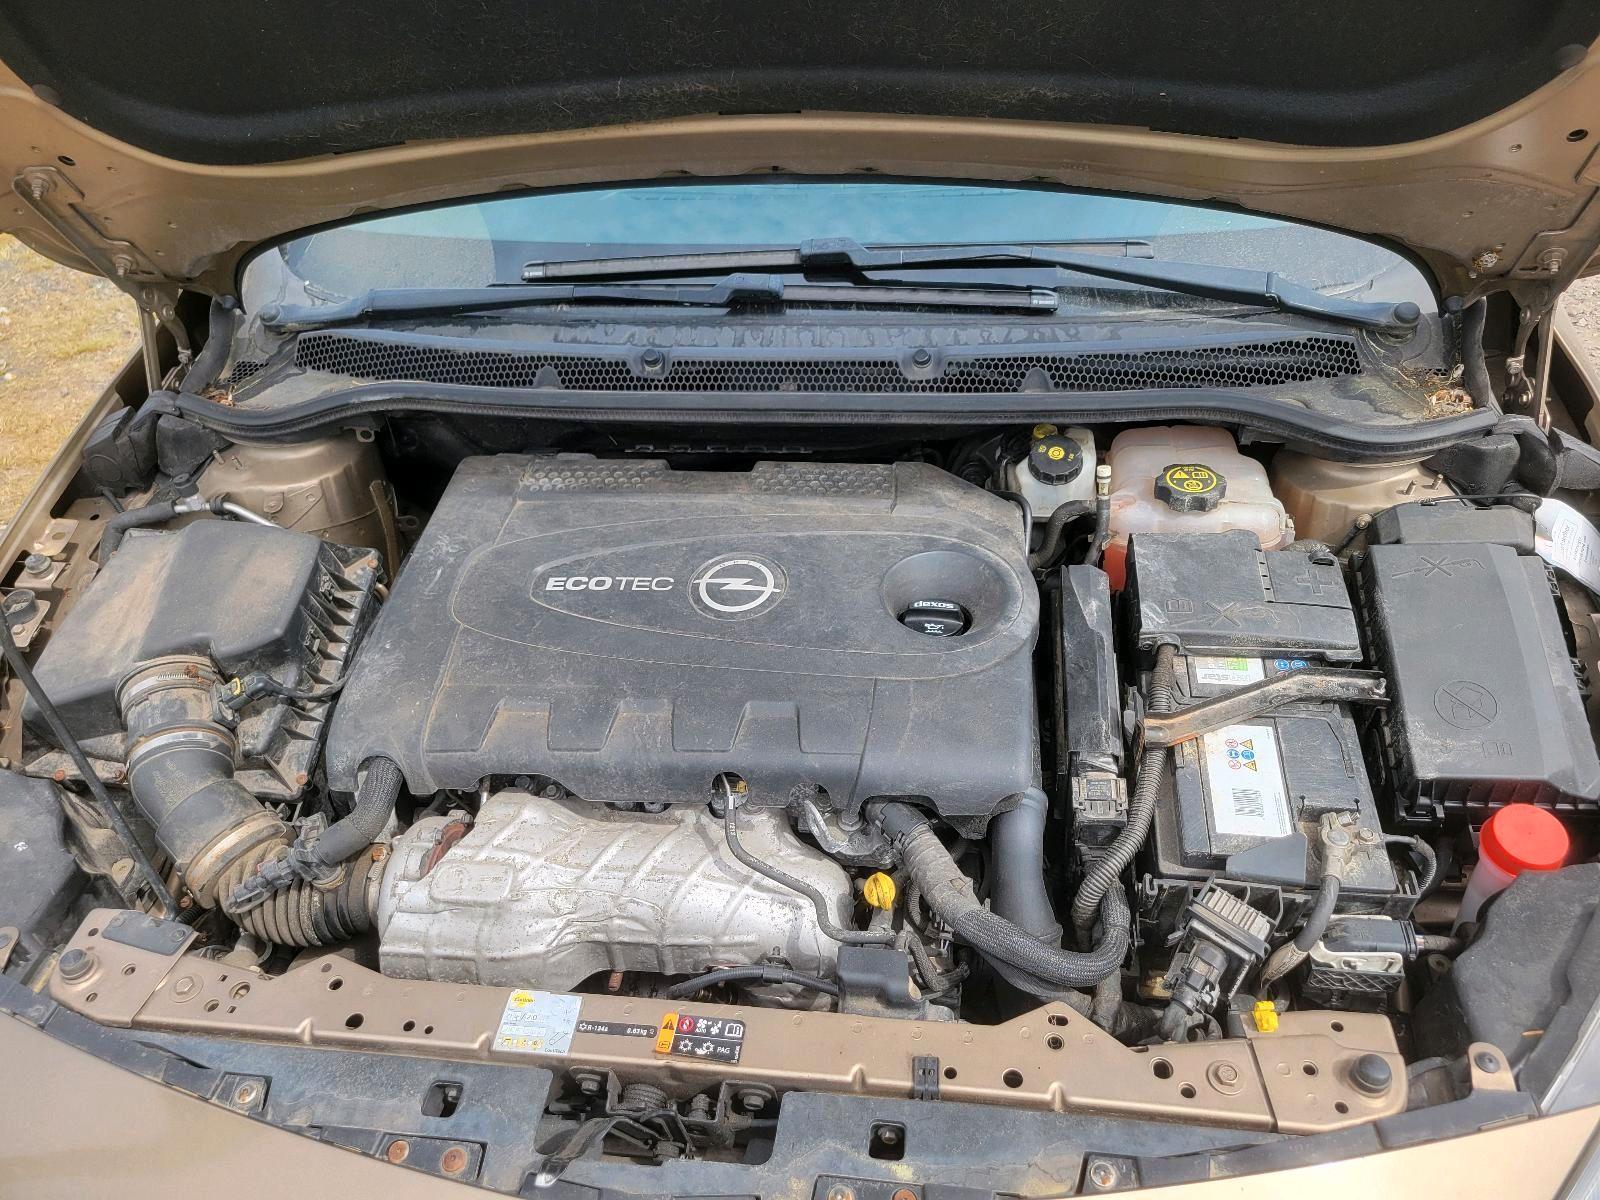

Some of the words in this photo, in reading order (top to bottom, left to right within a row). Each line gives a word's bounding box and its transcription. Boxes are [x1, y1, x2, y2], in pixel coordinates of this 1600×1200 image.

[545, 576, 675, 591] ECOTEC
[914, 600, 955, 609] dexos
[717, 1046, 731, 1054] PAG
